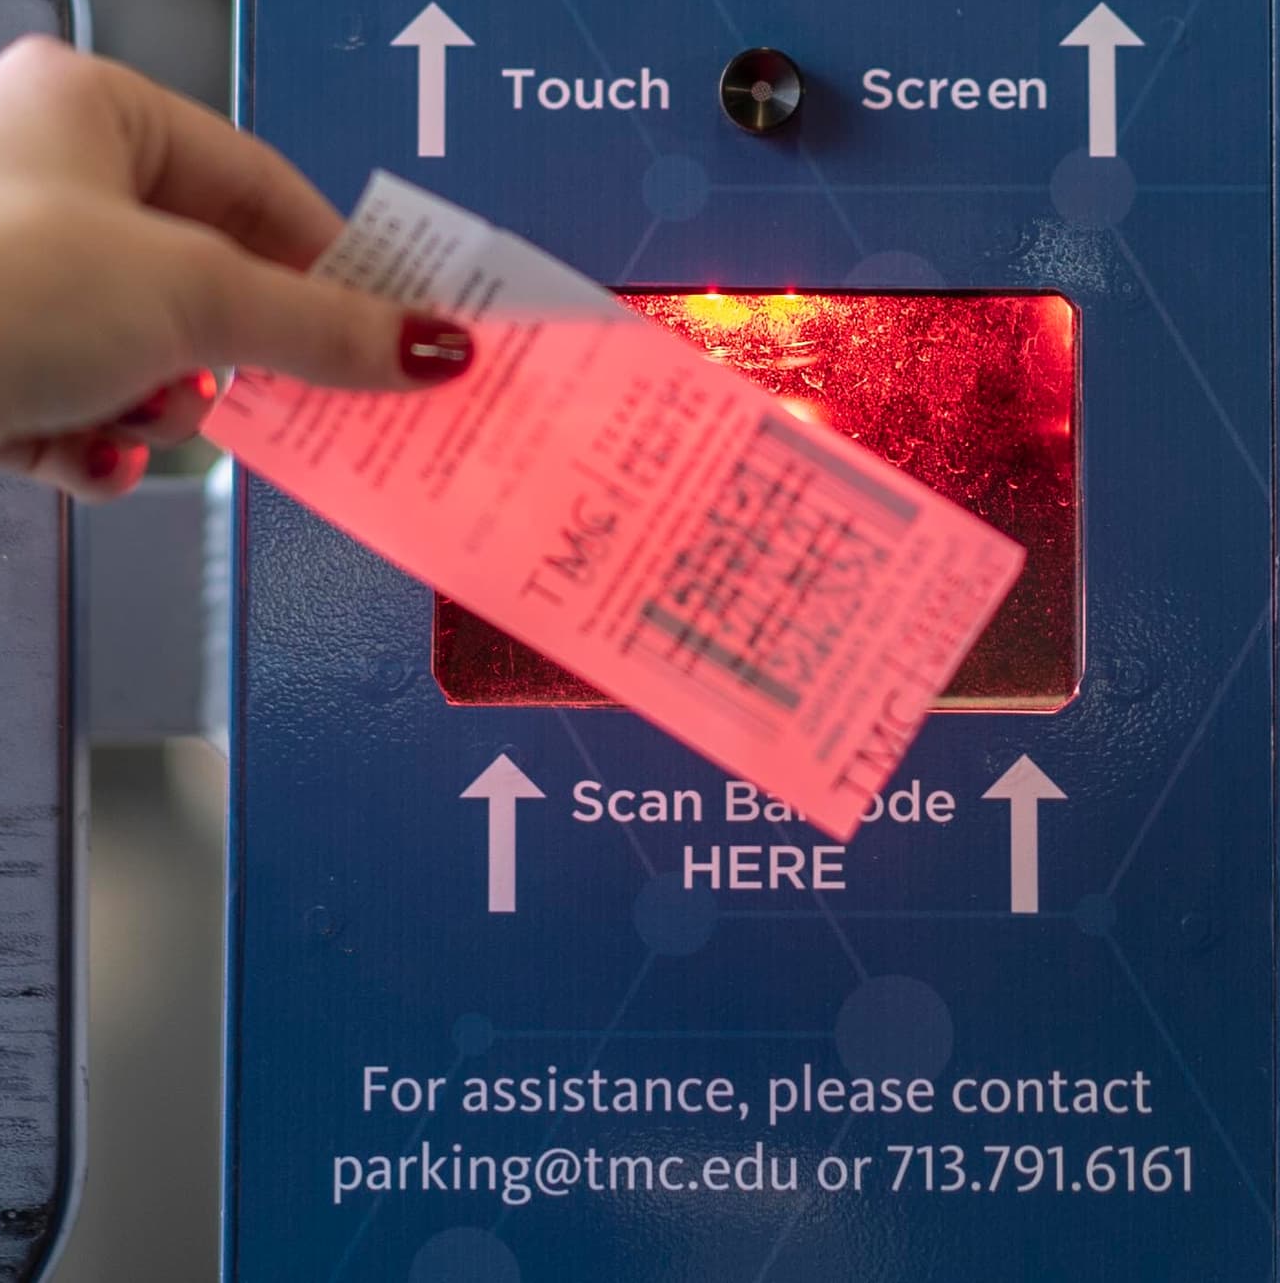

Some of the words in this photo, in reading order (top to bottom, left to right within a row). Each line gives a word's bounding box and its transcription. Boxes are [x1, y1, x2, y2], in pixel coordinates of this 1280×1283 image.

[501, 67, 669, 110] Touch
[863, 68, 1048, 110] Screen
[572, 780, 703, 822] Scan
[725, 779, 956, 822] Baode
[683, 845, 847, 889] HERE
[363, 1066, 447, 1112] For
[462, 1065, 750, 1120] assistance,
[769, 1063, 935, 1126] please
[952, 1070, 1153, 1114] contact
[333, 1141, 798, 1205] parking@tmc.edu
[817, 1156, 872, 1191] or
[887, 1145, 1192, 1192] 713.791.6161
